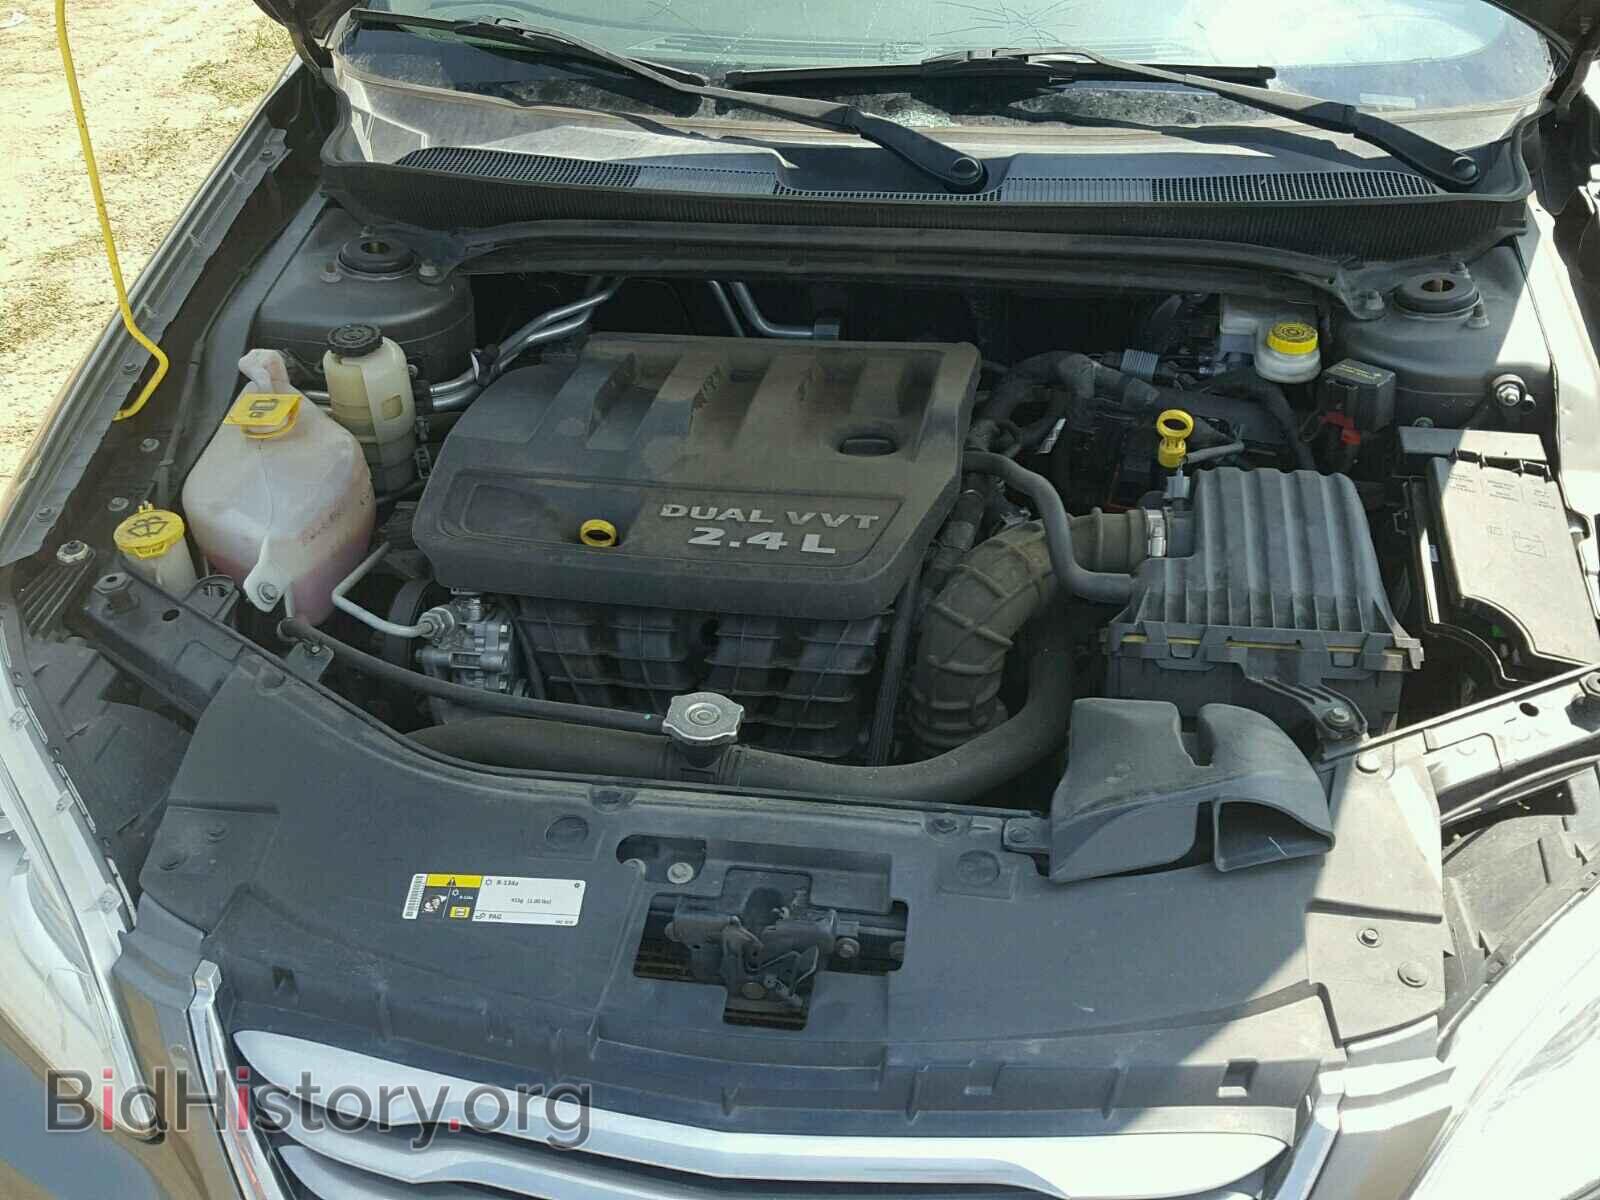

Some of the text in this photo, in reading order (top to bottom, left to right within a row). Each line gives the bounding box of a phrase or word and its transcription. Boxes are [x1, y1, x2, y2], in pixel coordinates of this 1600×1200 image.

[660, 504, 880, 529] DUAL VVT
[687, 527, 836, 554] 2.4 L
